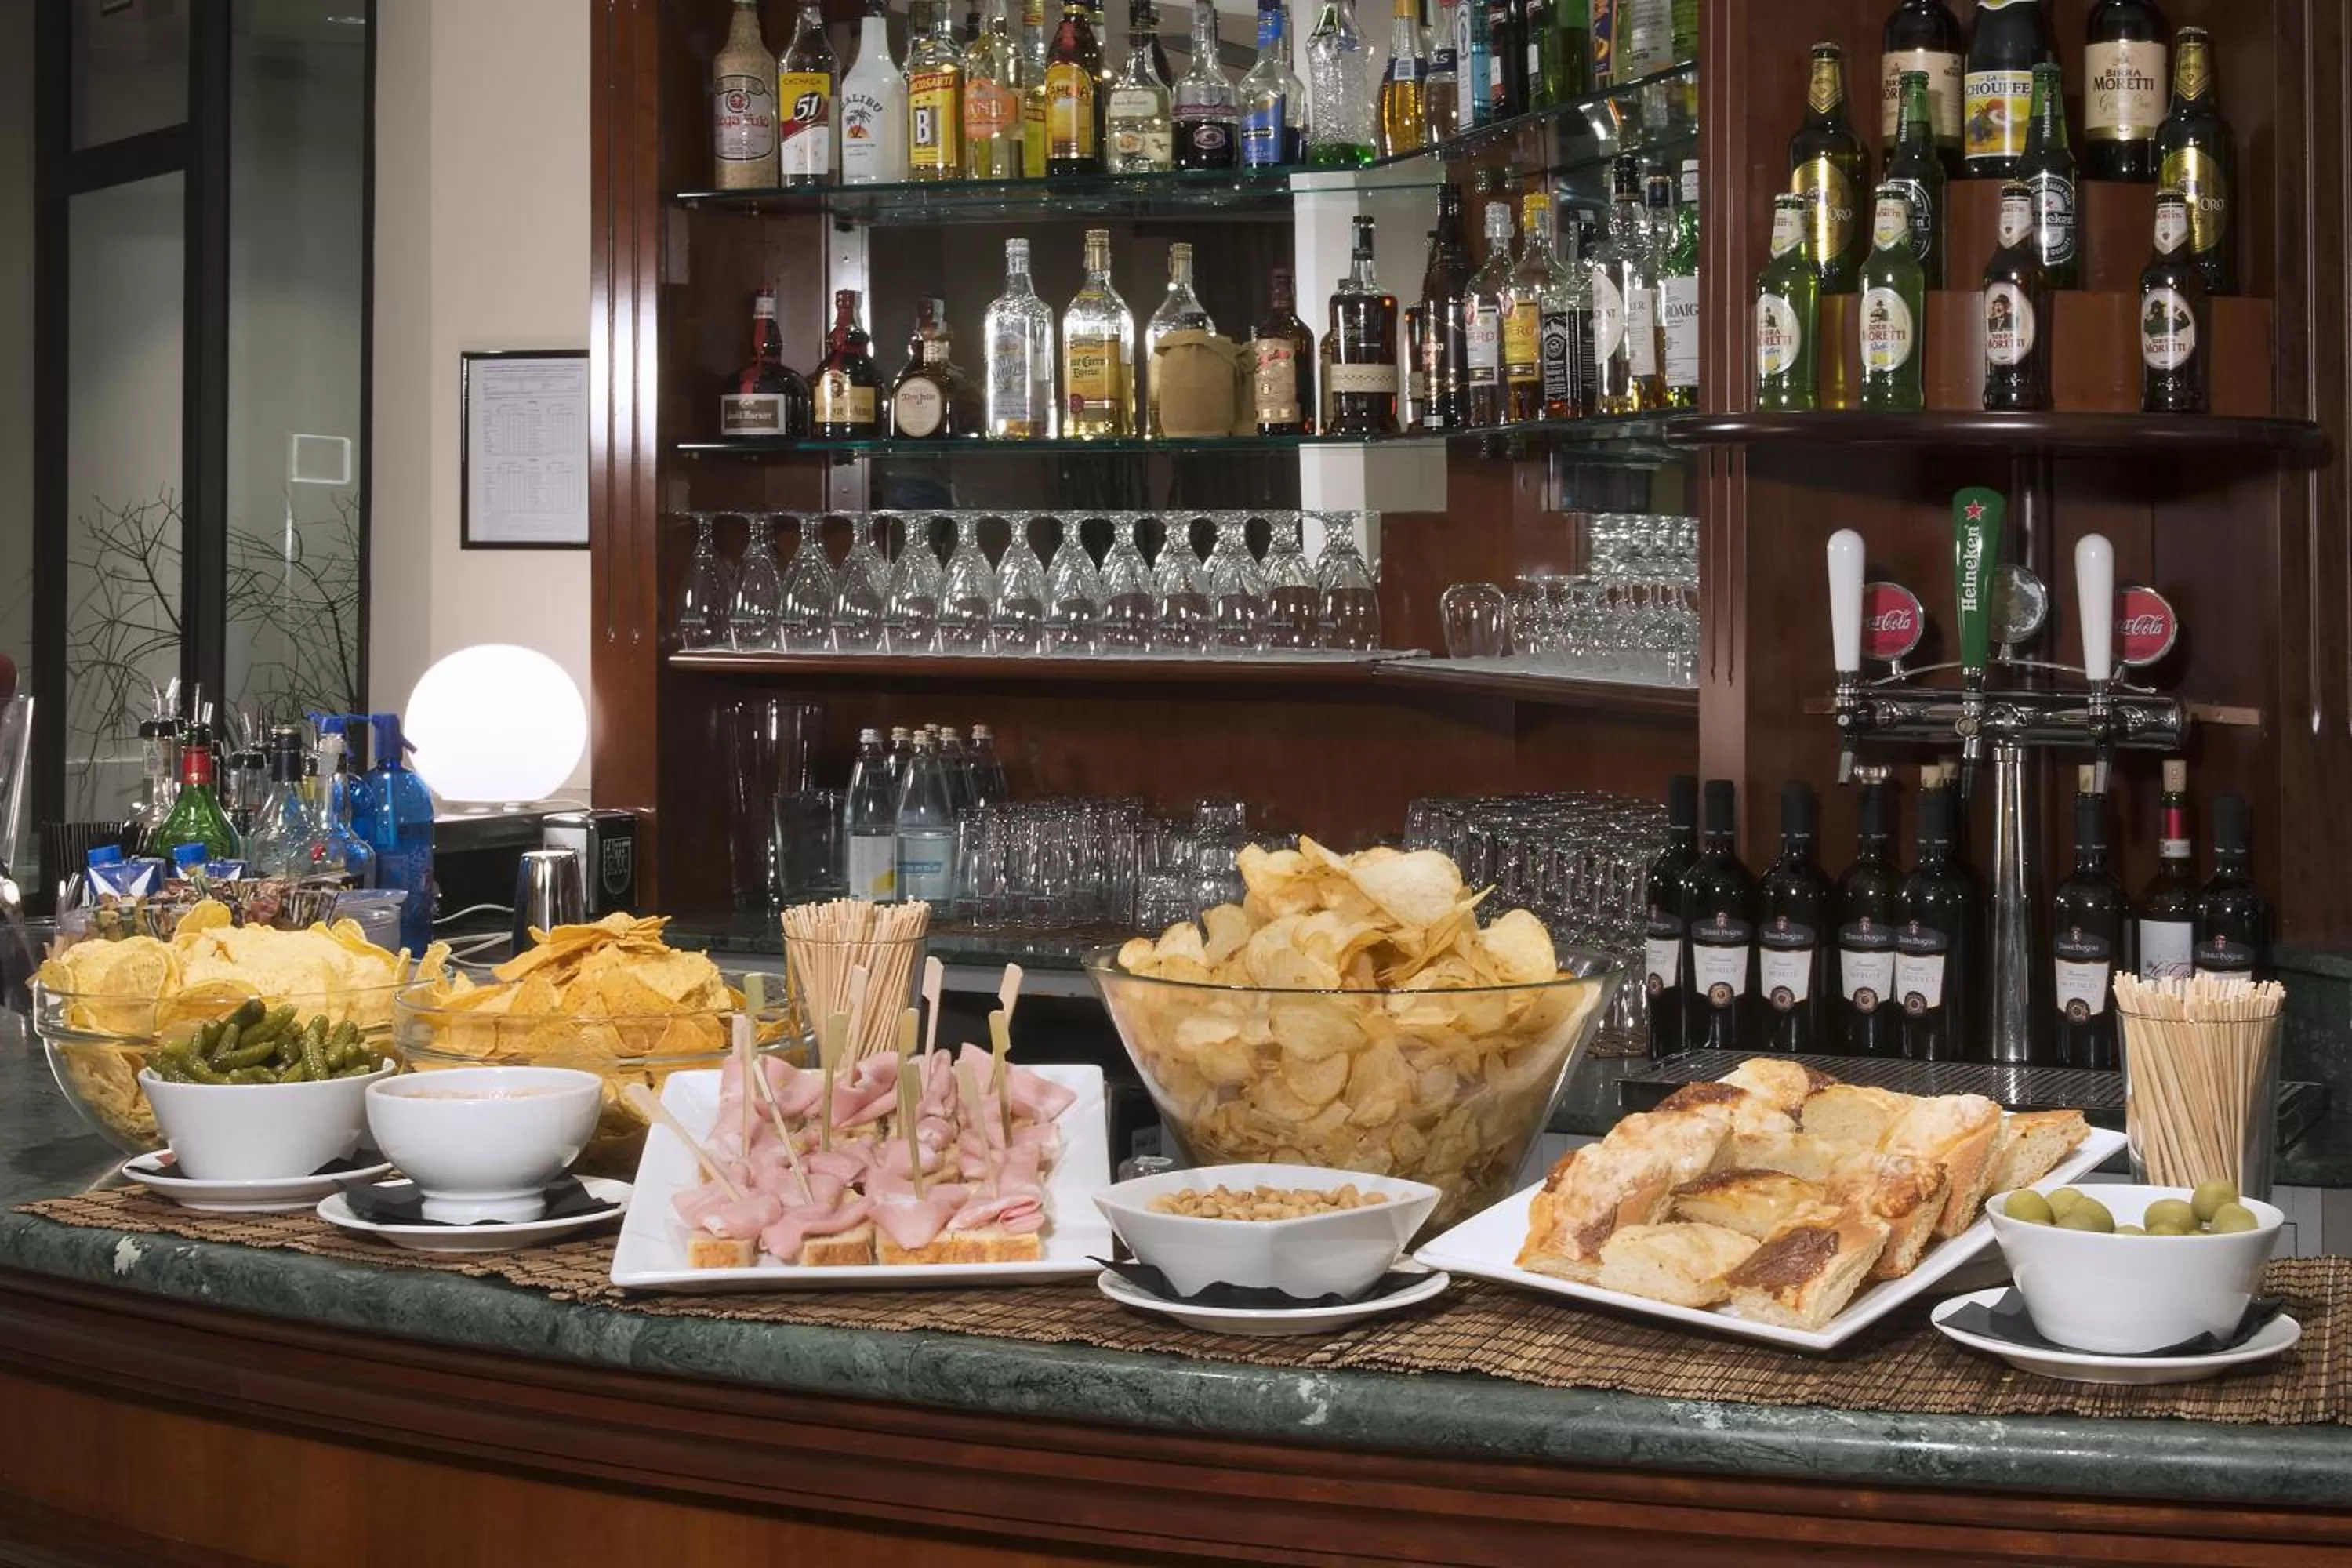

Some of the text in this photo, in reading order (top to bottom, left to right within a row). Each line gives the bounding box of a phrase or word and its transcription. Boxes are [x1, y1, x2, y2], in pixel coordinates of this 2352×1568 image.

[1966, 82, 2031, 95] CHOUFFE
[2093, 77, 2154, 91] MORETTI
[793, 93, 820, 121] 51
[1961, 526, 1980, 612] Heineken
